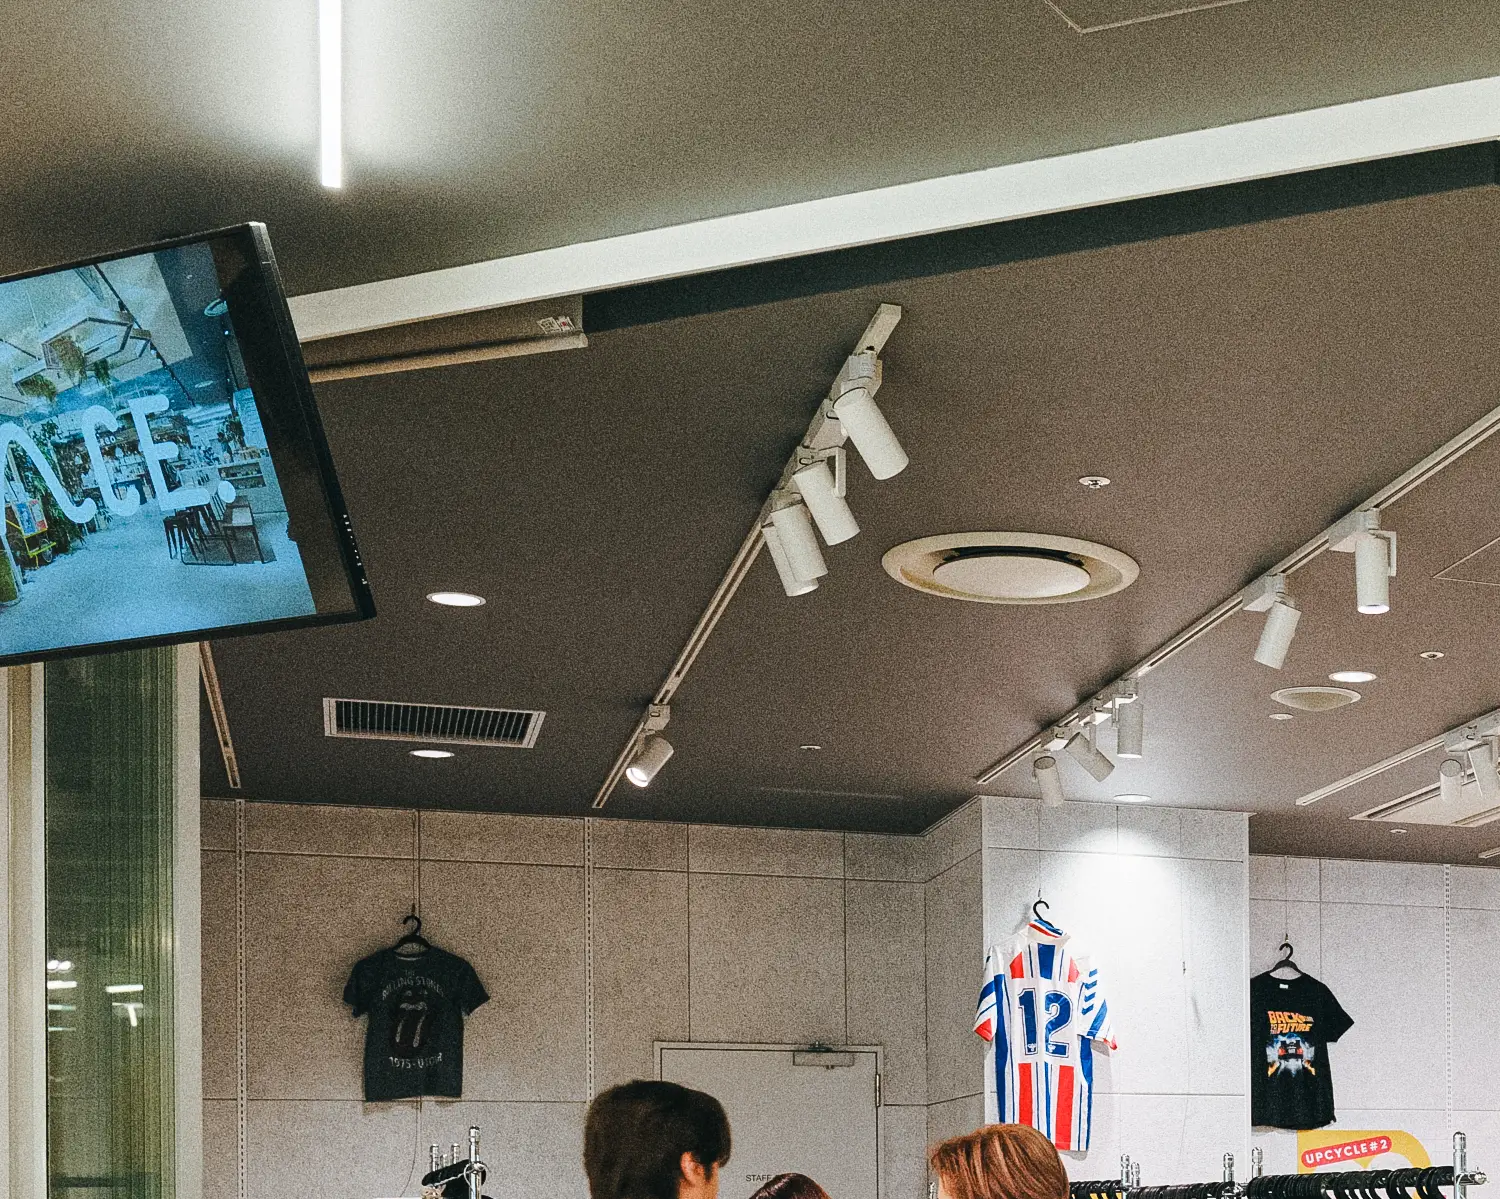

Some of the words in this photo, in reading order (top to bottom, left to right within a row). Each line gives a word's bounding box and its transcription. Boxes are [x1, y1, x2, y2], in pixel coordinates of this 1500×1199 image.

[1017, 987, 1074, 1058] 12
[1267, 1011, 1306, 1024] BACK
[1277, 1024, 1313, 1034] FUTURE
[745, 1174, 772, 1182] STAFF
